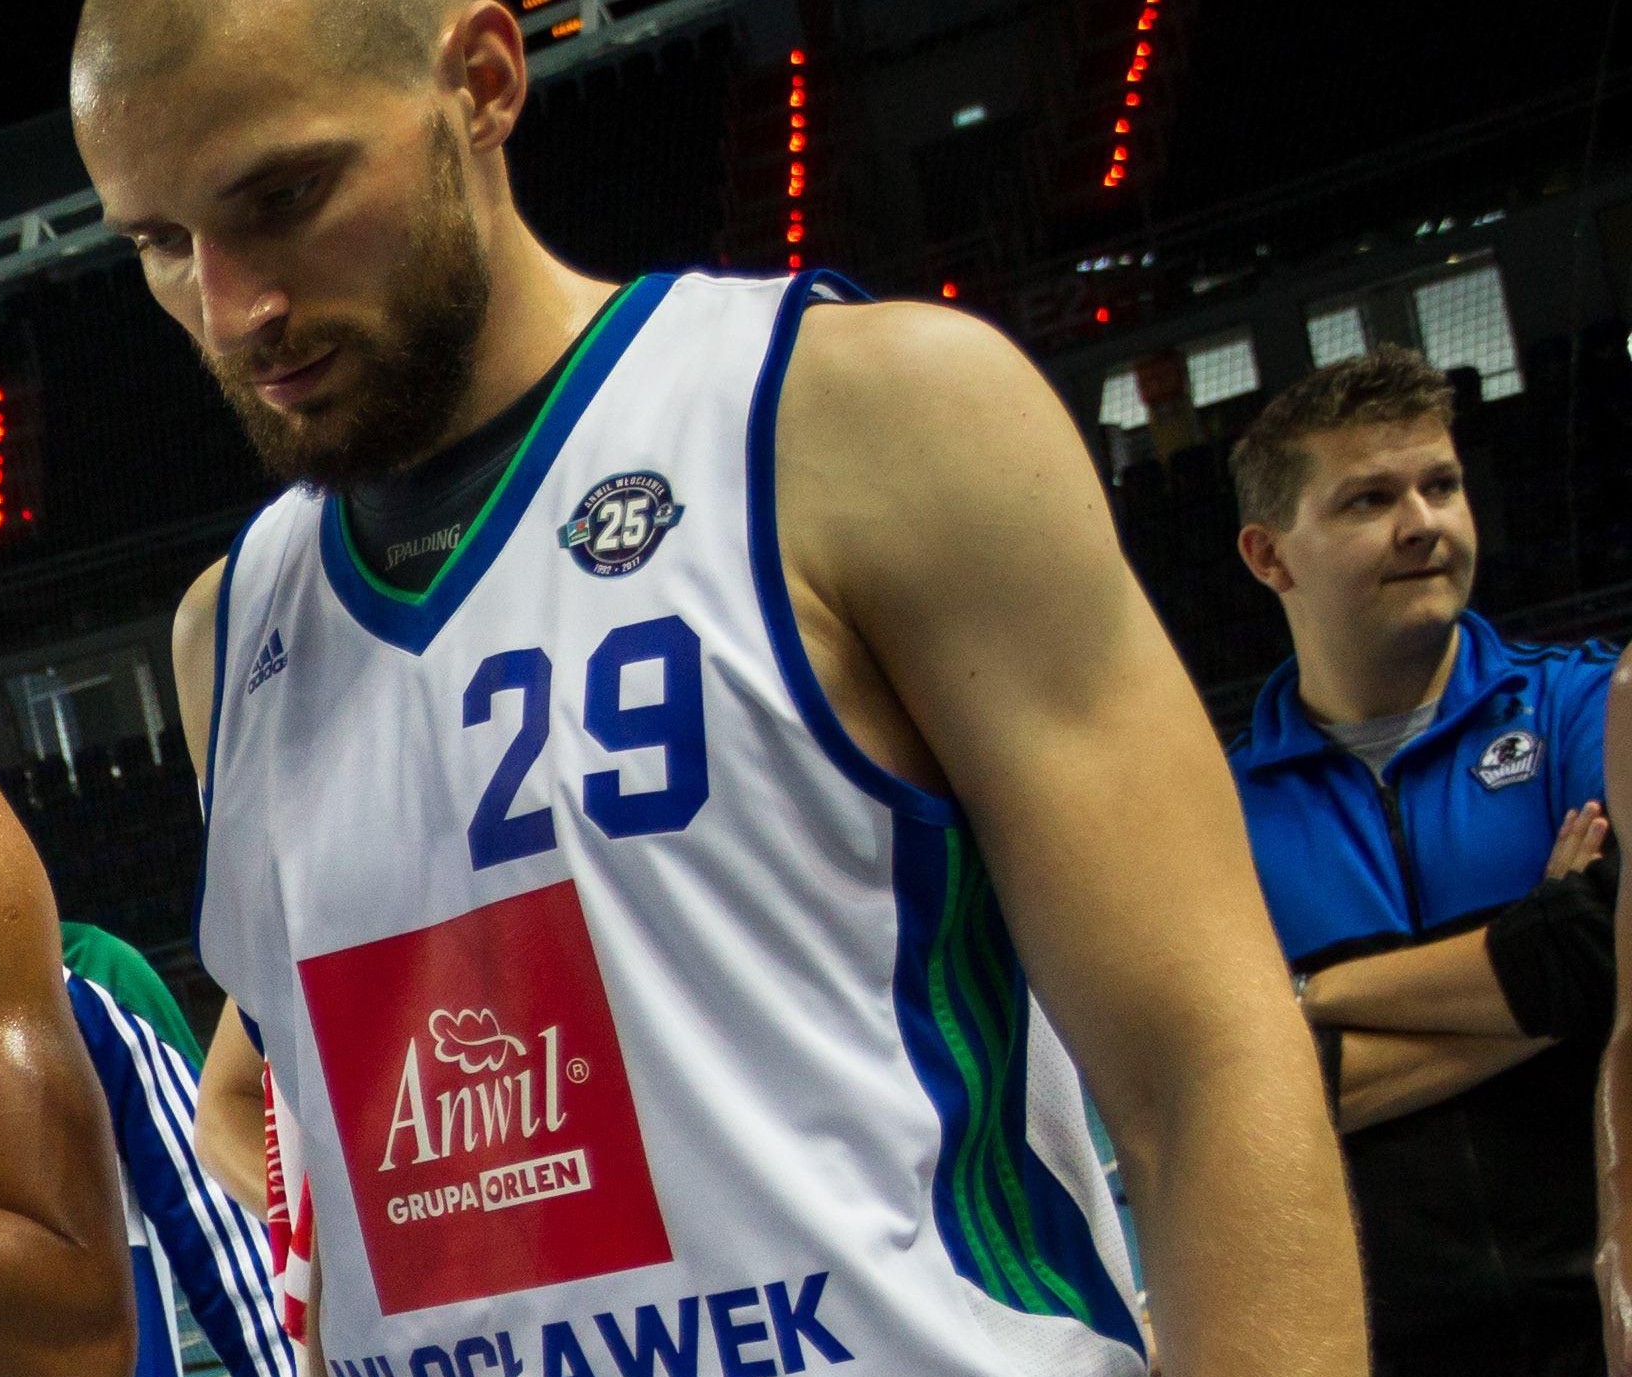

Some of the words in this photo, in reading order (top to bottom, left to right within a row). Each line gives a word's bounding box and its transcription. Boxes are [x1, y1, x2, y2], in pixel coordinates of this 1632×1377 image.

[384, 523, 461, 571] SPALDING
[594, 498, 649, 553] 25
[461, 614, 710, 872] 29
[378, 1025, 567, 1172] Anwil
[386, 1182, 479, 1225] GRUPA
[485, 1157, 581, 1204] ORLEN
